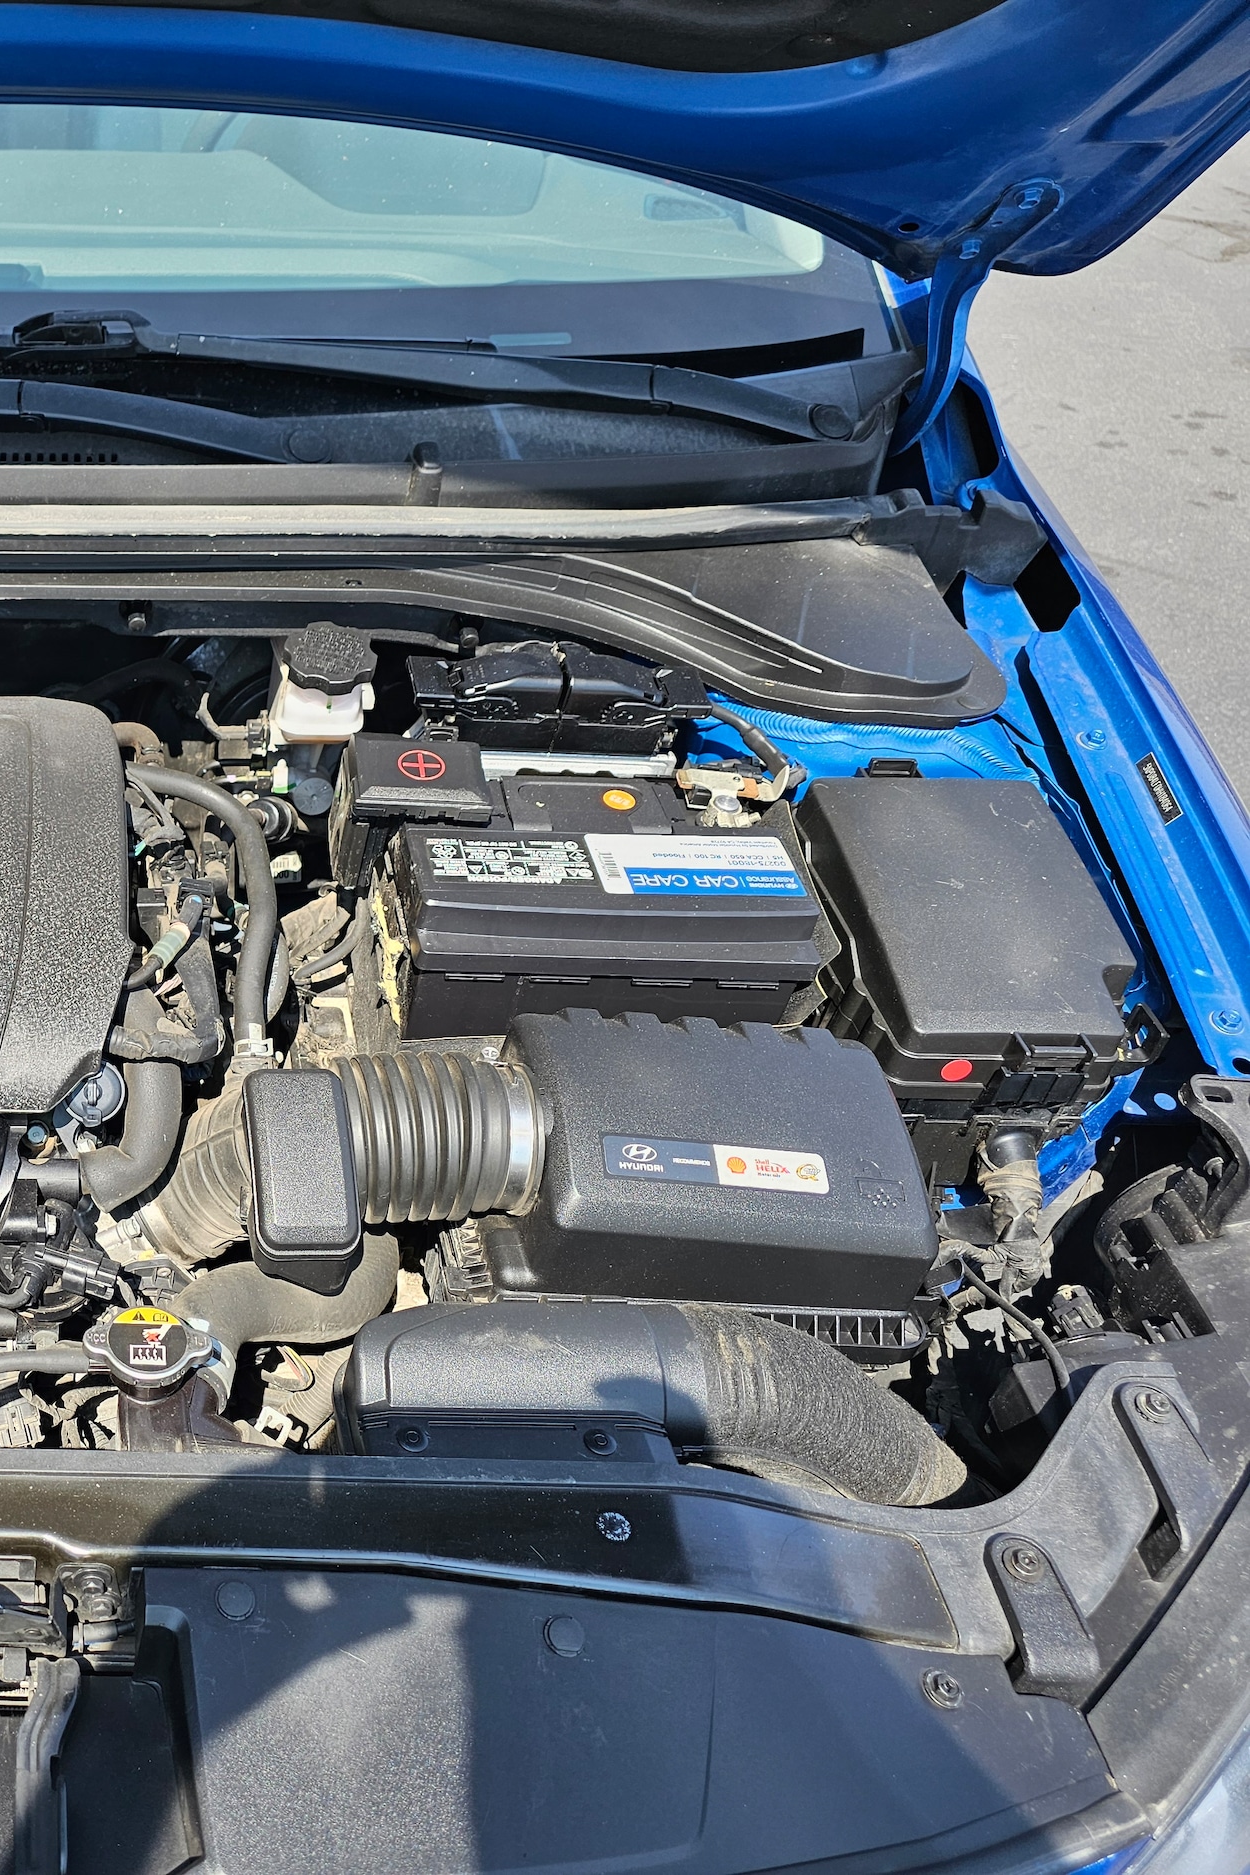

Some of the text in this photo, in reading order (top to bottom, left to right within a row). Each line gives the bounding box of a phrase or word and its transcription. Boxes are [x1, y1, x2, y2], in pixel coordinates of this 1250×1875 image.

[630, 873, 738, 888] CAR CARE
[619, 1161, 664, 1173] HYUNDAI
[756, 1164, 788, 1174] HELIX
